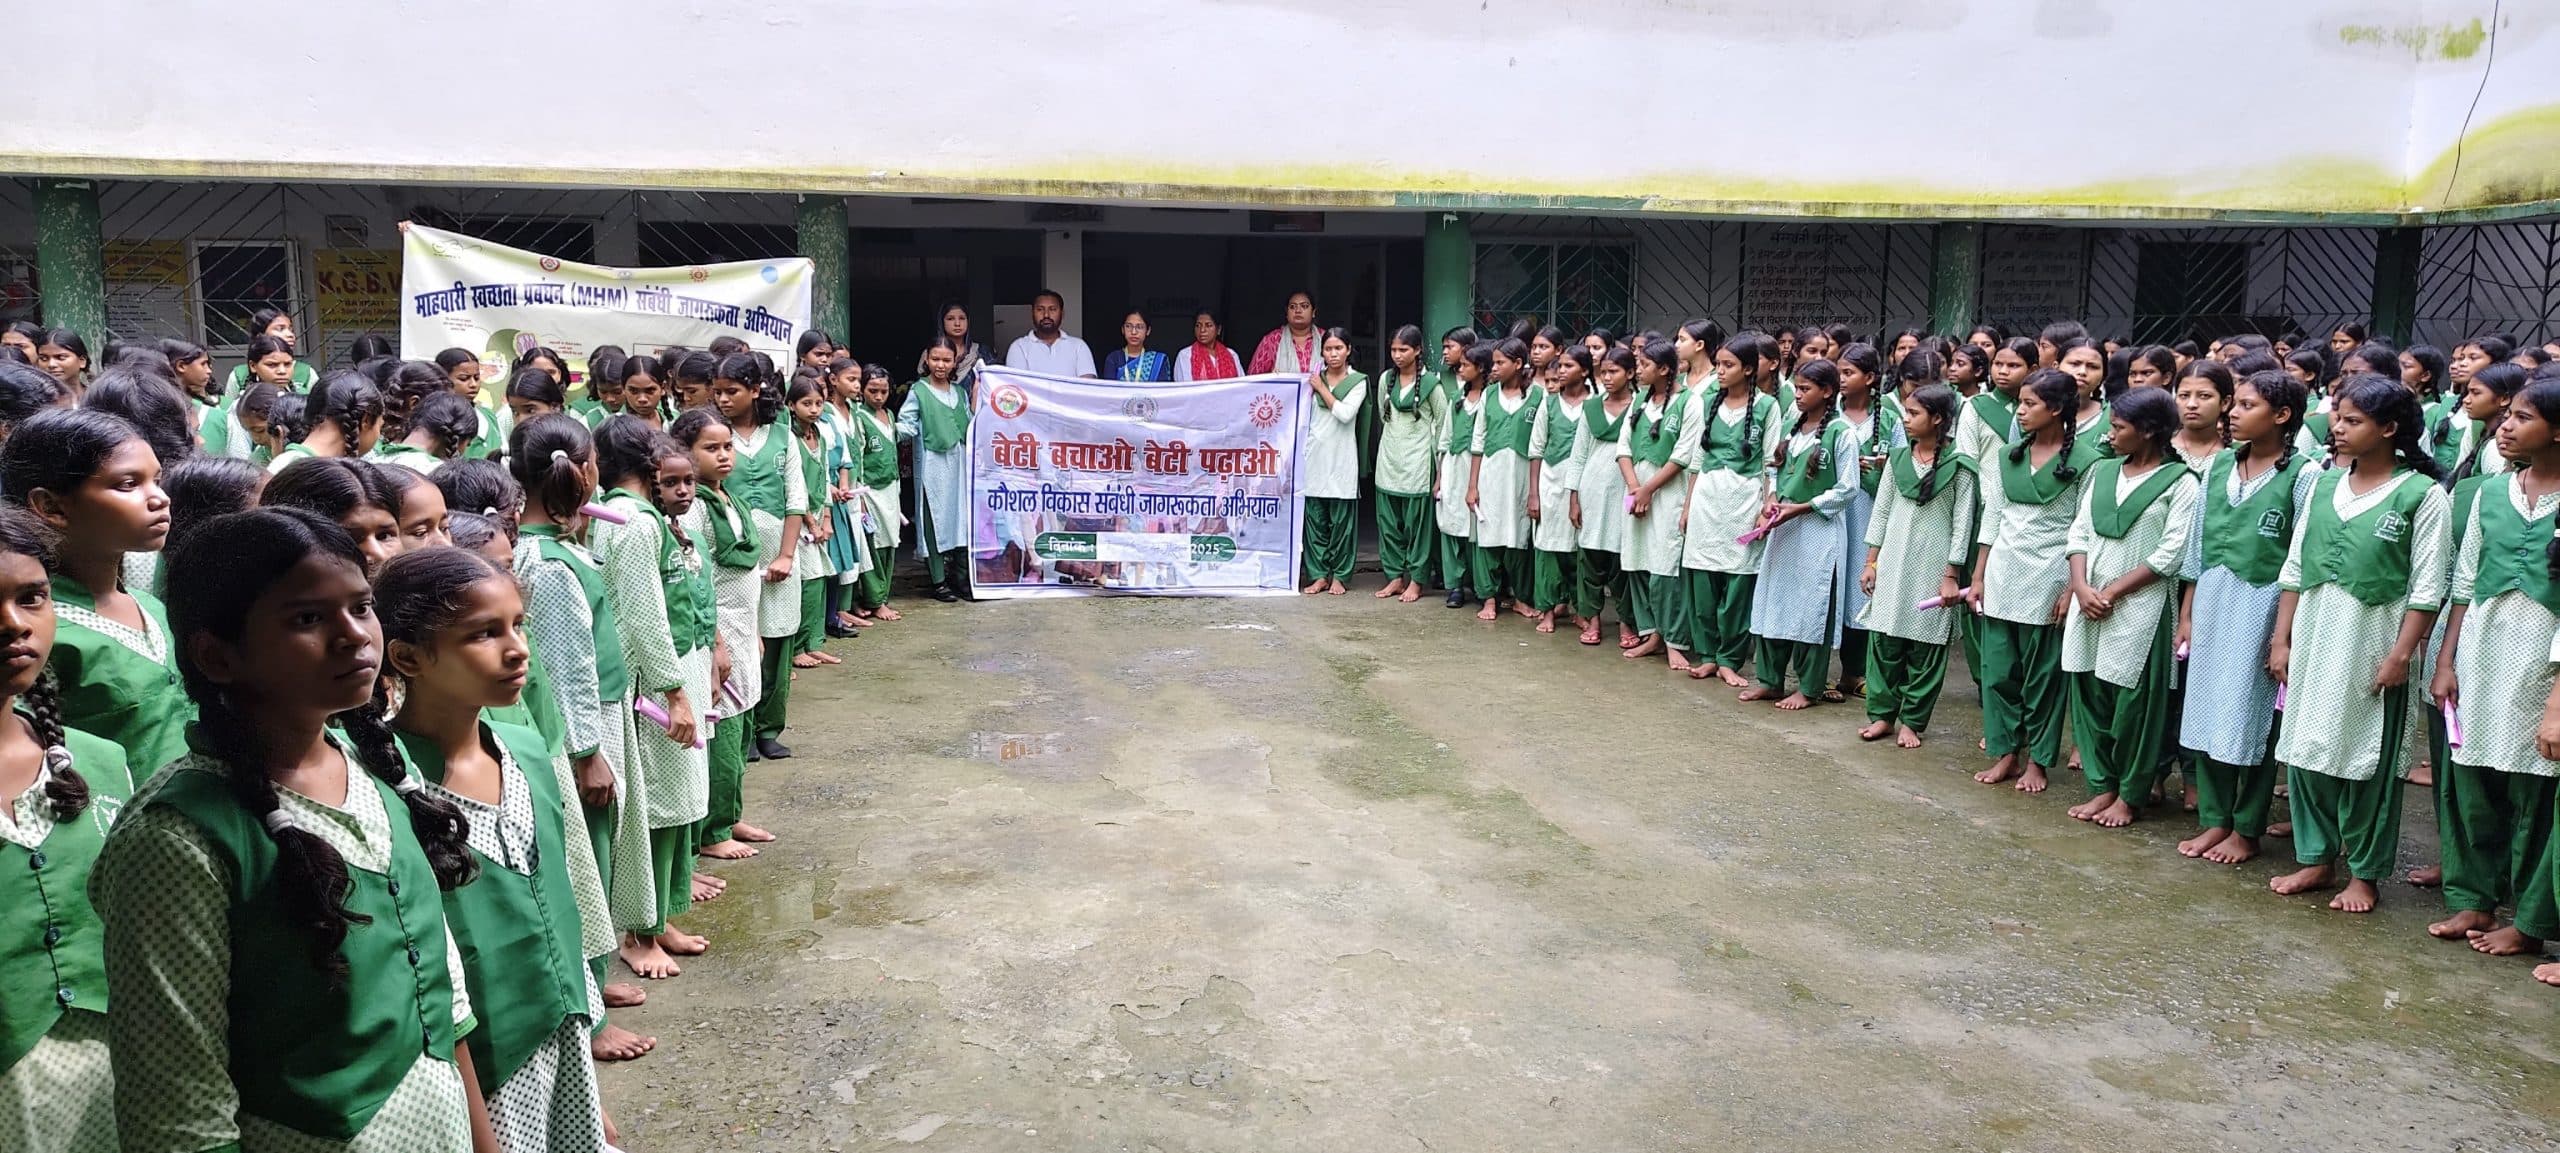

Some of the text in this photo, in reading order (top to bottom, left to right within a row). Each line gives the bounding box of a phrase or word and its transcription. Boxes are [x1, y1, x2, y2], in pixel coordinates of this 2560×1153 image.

[414, 280, 467, 318] माहवारी
[471, 283, 518, 309] स्वच्छता
[571, 281, 628, 310] (MHM)
[743, 305, 794, 345] अभियान
[991, 431, 1279, 481] बेटी बचाओ बेटी पढ़ाओ
[987, 481, 1280, 518] कौशल विकास संबंधी जागरूकता अभियान
[1048, 536, 1087, 553] दिनांक
[1191, 543, 1220, 556] 2025
